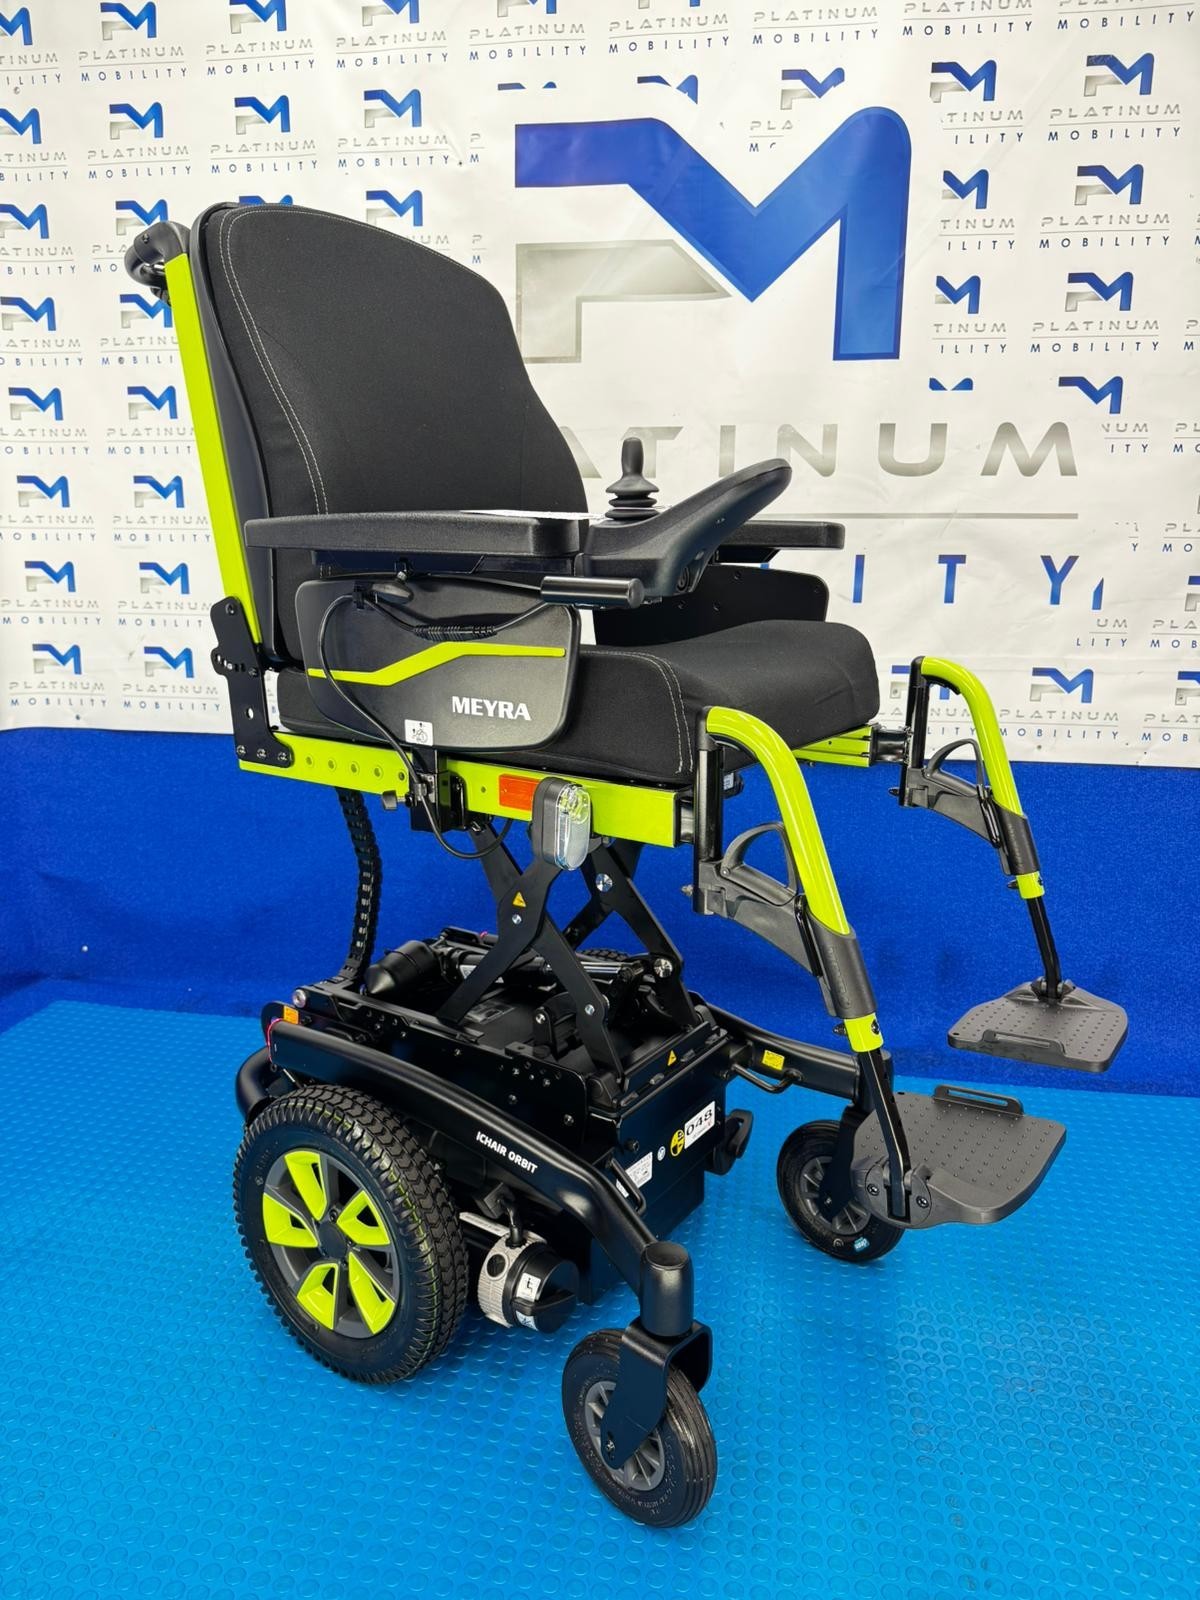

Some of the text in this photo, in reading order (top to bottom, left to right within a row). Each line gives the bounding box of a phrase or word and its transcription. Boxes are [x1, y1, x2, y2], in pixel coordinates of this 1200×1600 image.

[754, 6, 877, 22] PLATINUM
[1058, 11, 1194, 29] MOBILITY
[609, 14, 728, 32] PLATINUM
[903, 21, 1032, 35] MOBILITY
[469, 22, 585, 39] PLATINUM
[753, 29, 878, 44] MOBILITY
[336, 31, 447, 47] PLATINUM
[609, 36, 729, 53] MOBILITY
[79, 46, 184, 60] PLATINUM
[206, 39, 313, 55] PLATINUM
[470, 46, 586, 60] MOBILITY
[208, 60, 314, 75] MOBILITY
[337, 53, 448, 68] MOBILITY
[81, 68, 187, 82] MOBILITY
[941, 109, 1023, 123] TINUM
[1050, 104, 1180, 119] PLATINUM
[337, 134, 448, 148] PLATINUM
[1048, 127, 1180, 142] MOBILITY
[88, 145, 189, 159] PLATINUM
[210, 139, 316, 154] PLATINUM
[0, 151, 67, 162] TINUM
[338, 155, 448, 168] MOBILITY
[89, 166, 191, 179] MOBILITY
[212, 160, 318, 174] MOBILITY
[1041, 213, 1170, 227] PLATINUM
[1039, 236, 1170, 249] MOBILITY
[1032, 320, 1159, 332] PLATINUM
[1030, 341, 1159, 353] MOBILITY
[0, 515, 94, 524] LATINUM
[113, 516, 208, 524] PLATINUM
[114, 534, 211, 542] MOBILITY
[3, 617, 101, 626] MOBILITY
[9, 681, 104, 690] PLATINUM
[123, 684, 218, 694] PLATINUM
[11, 699, 106, 707] MOBILITY
[124, 701, 220, 711] MOBILITY
[452, 696, 532, 721] MEYRA
[1000, 709, 1119, 721] PLATINUM
[686, 1109, 713, 1136] 048
[476, 1131, 539, 1174] ICHAIR ORBIT
